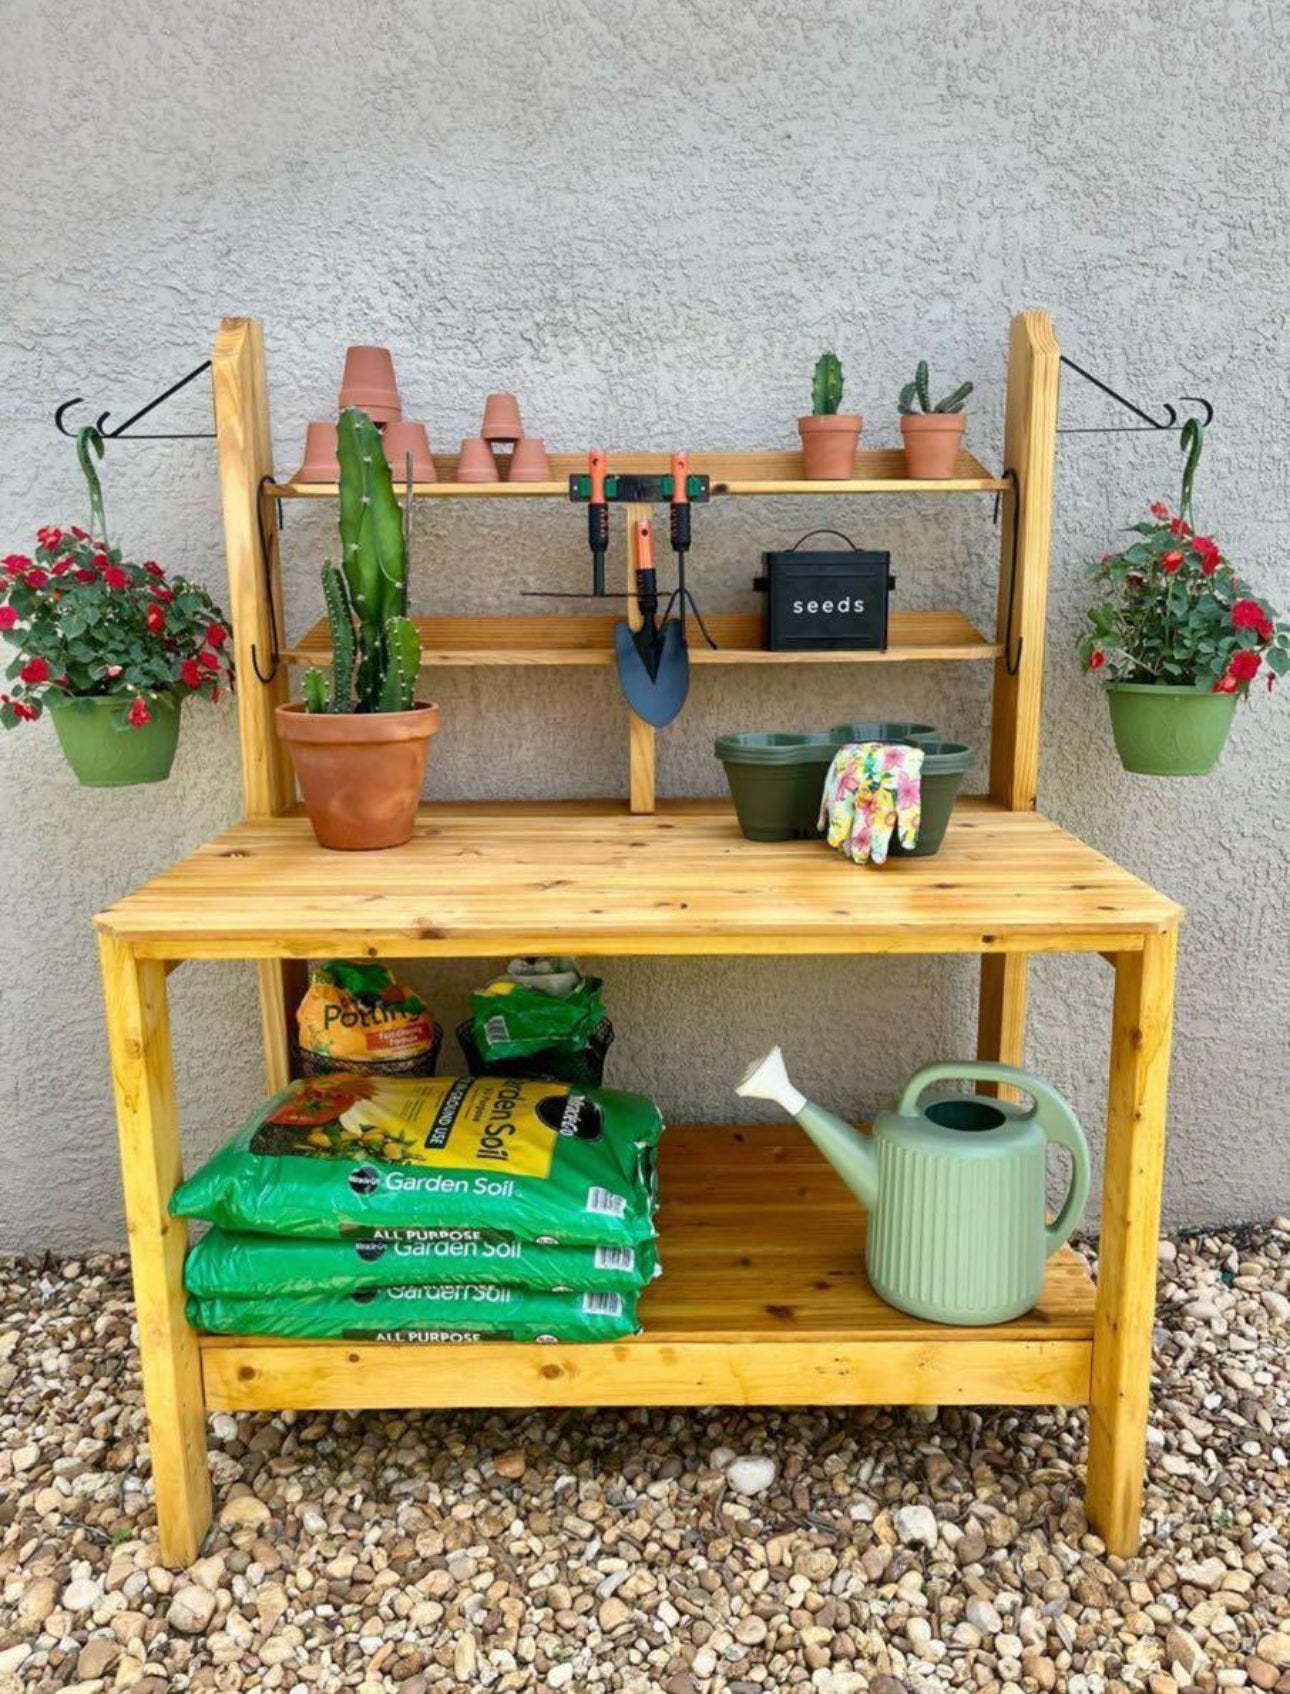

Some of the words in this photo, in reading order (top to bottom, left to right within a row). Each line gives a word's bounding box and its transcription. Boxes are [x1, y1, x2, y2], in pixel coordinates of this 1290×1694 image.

[792, 596, 865, 614] seeds
[488, 1079, 526, 1122] arden
[429, 1127, 448, 1145] USE
[477, 1123, 517, 1161] Soil
[385, 1171, 468, 1193] Garden
[472, 1177, 515, 1198] Soil
[373, 1229, 403, 1240] ALL
[406, 1230, 481, 1241] PURPOSE
[394, 1241, 477, 1258] Garden
[481, 1241, 521, 1259] Soil
[376, 1332, 405, 1342] ALL
[407, 1331, 481, 1343] PURPOSE
